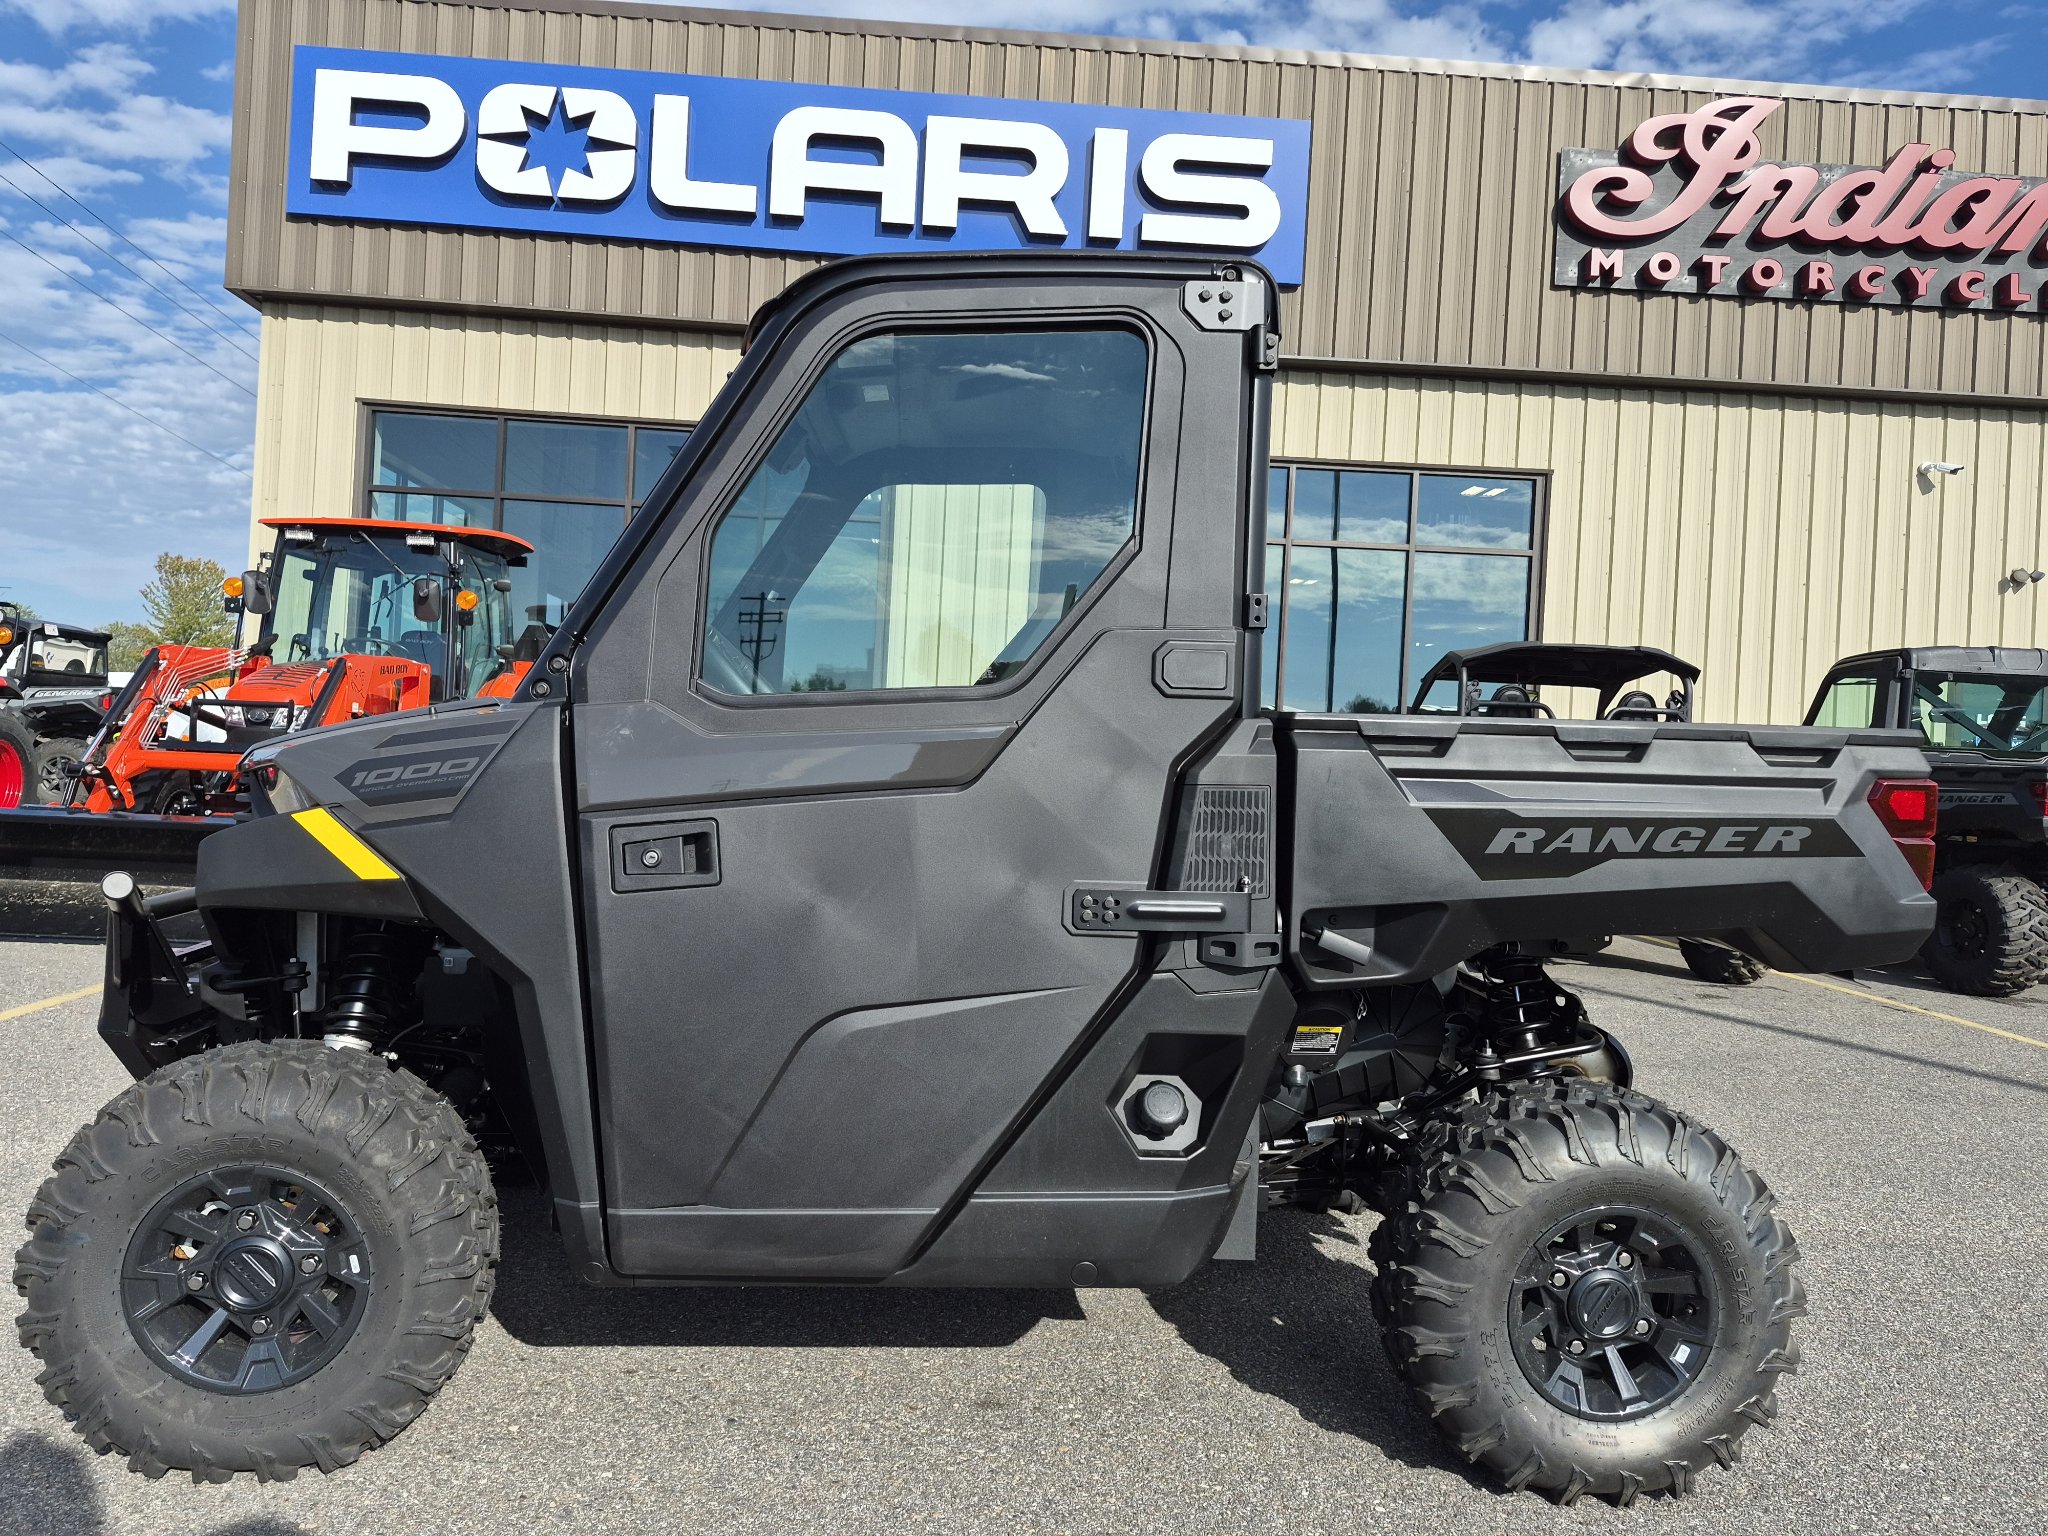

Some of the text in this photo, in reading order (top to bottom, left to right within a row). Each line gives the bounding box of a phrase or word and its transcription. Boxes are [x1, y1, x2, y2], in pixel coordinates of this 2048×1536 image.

[309, 68, 1282, 247] POLARIS
[1589, 248, 2032, 303] MOTORCYCL
[380, 664, 410, 675] BAD BOY
[34, 689, 95, 698] GENERAL
[351, 756, 480, 787] 1000
[359, 784, 394, 793] SINGLE
[396, 776, 447, 788] OVERHEAD
[1484, 826, 1812, 854] RANGER
[141, 1136, 285, 1183] CARLSTAR
[1701, 1215, 1753, 1325] CARLSTAR
